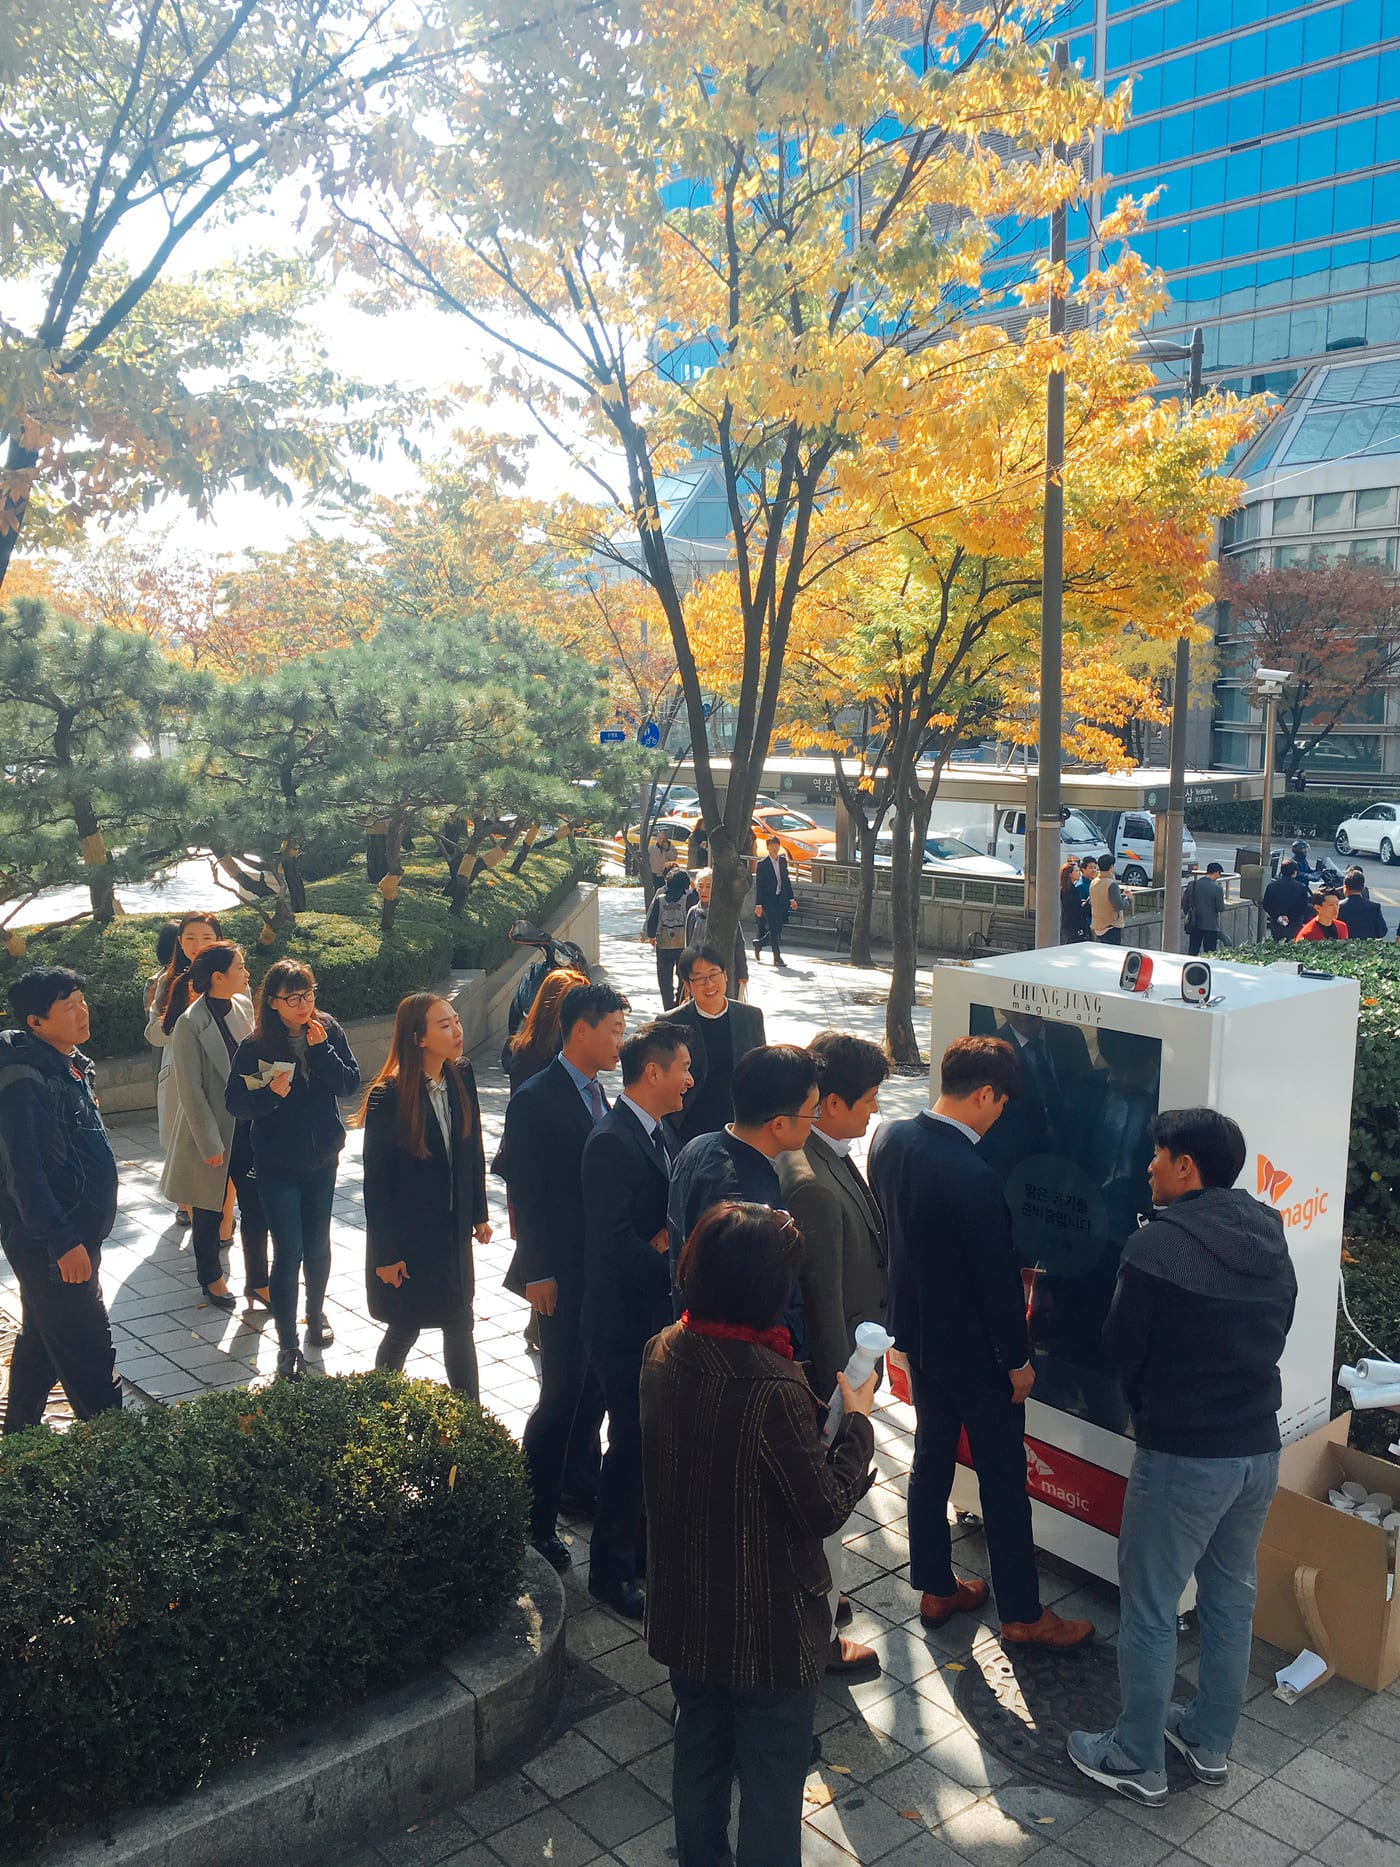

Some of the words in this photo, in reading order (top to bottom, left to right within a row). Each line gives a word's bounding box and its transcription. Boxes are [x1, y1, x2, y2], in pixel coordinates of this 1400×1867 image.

[812, 778, 833, 792] 역삼
[1184, 787, 1193, 804] 삼
[1013, 983, 1059, 1005] CHUNG
[1063, 991, 1102, 1013] JUNG
[1012, 1001, 1061, 1016] magic
[1076, 1013, 1102, 1024] air
[1041, 1480, 1090, 1512] magic
